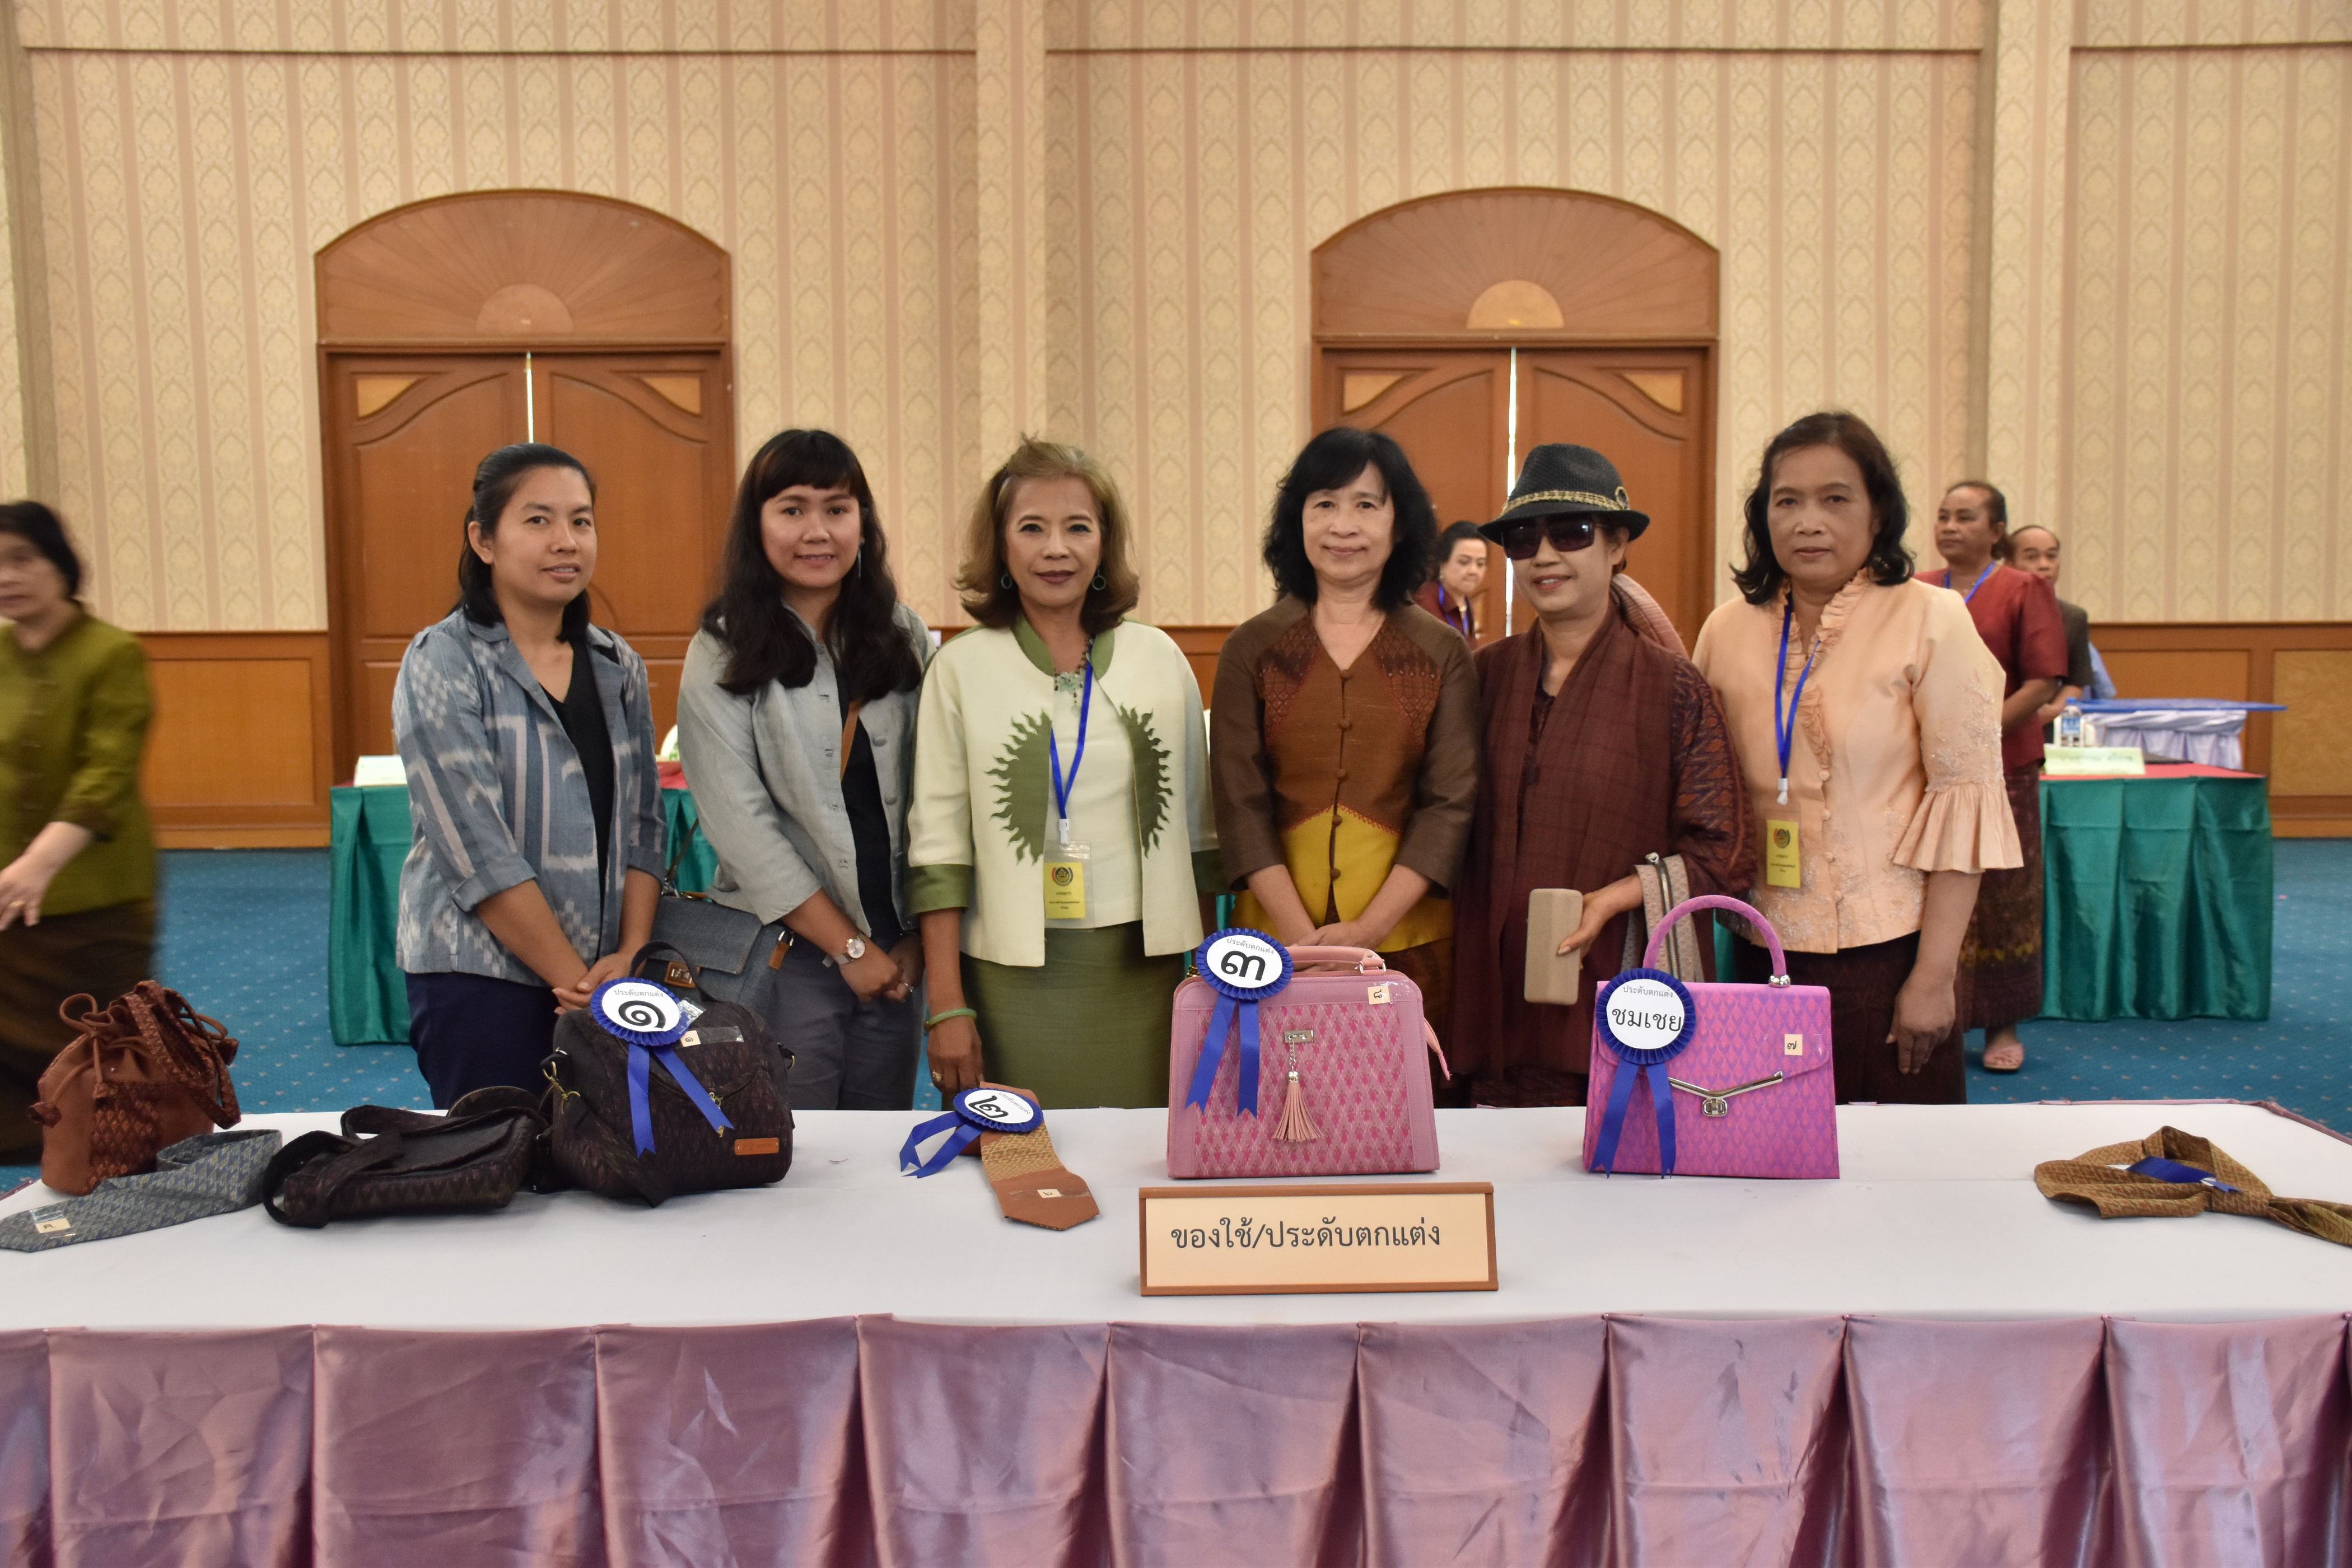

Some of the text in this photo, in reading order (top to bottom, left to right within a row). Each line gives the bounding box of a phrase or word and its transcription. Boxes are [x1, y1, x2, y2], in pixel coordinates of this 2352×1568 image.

[1226, 938, 1275, 954] ประดับตกแต่ง
[1221, 950, 1266, 981] ๓
[613, 988, 664, 998] ประดับตกแต่ง
[1622, 984, 1674, 998] ประดับตกแต่ง
[618, 1000, 666, 1029] ๑
[1612, 1009, 1682, 1032] ชมเชย
[1787, 1040, 1797, 1050] ๗
[968, 1095, 1009, 1118] ๒
[1170, 1216, 1441, 1249] ของใช้/ประดับตกแต่ง
